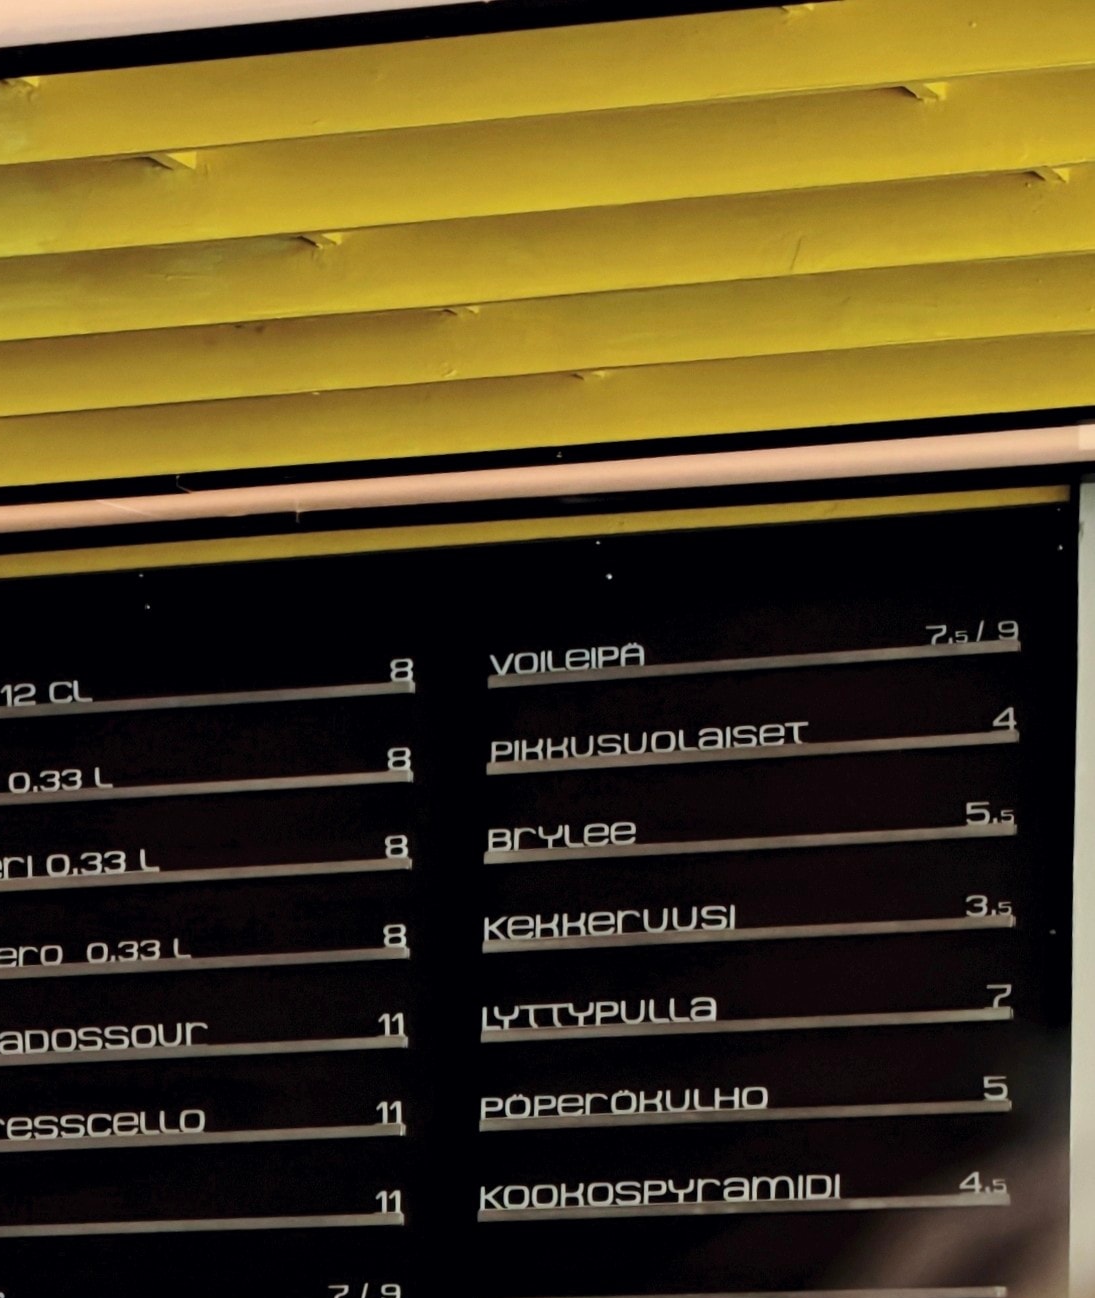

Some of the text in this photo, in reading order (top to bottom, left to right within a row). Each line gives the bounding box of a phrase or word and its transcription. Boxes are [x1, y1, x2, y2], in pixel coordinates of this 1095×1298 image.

[976, 621, 985, 642] /
[997, 621, 1019, 641] 9
[0, 683, 37, 707] 12
[49, 680, 93, 705] CL
[390, 659, 413, 682] 8
[491, 707, 1017, 764] PIKKUSUOLAISET 4
[95, 767, 113, 789] L
[387, 747, 411, 770] 8
[140, 849, 160, 872] L
[385, 835, 408, 858] 8
[488, 822, 636, 852] BRYLEE
[484, 904, 735, 941] KEKKERUUSI
[174, 938, 191, 959] L
[383, 924, 406, 947] 8
[379, 1012, 405, 1037] 11
[482, 984, 1012, 1031] LYTTYPULLA 7
[983, 1076, 1007, 1101] 5
[376, 1101, 403, 1124] 11
[375, 1190, 402, 1214] 11
[480, 1174, 840, 1210] KOOKOSPYRAMIDI
